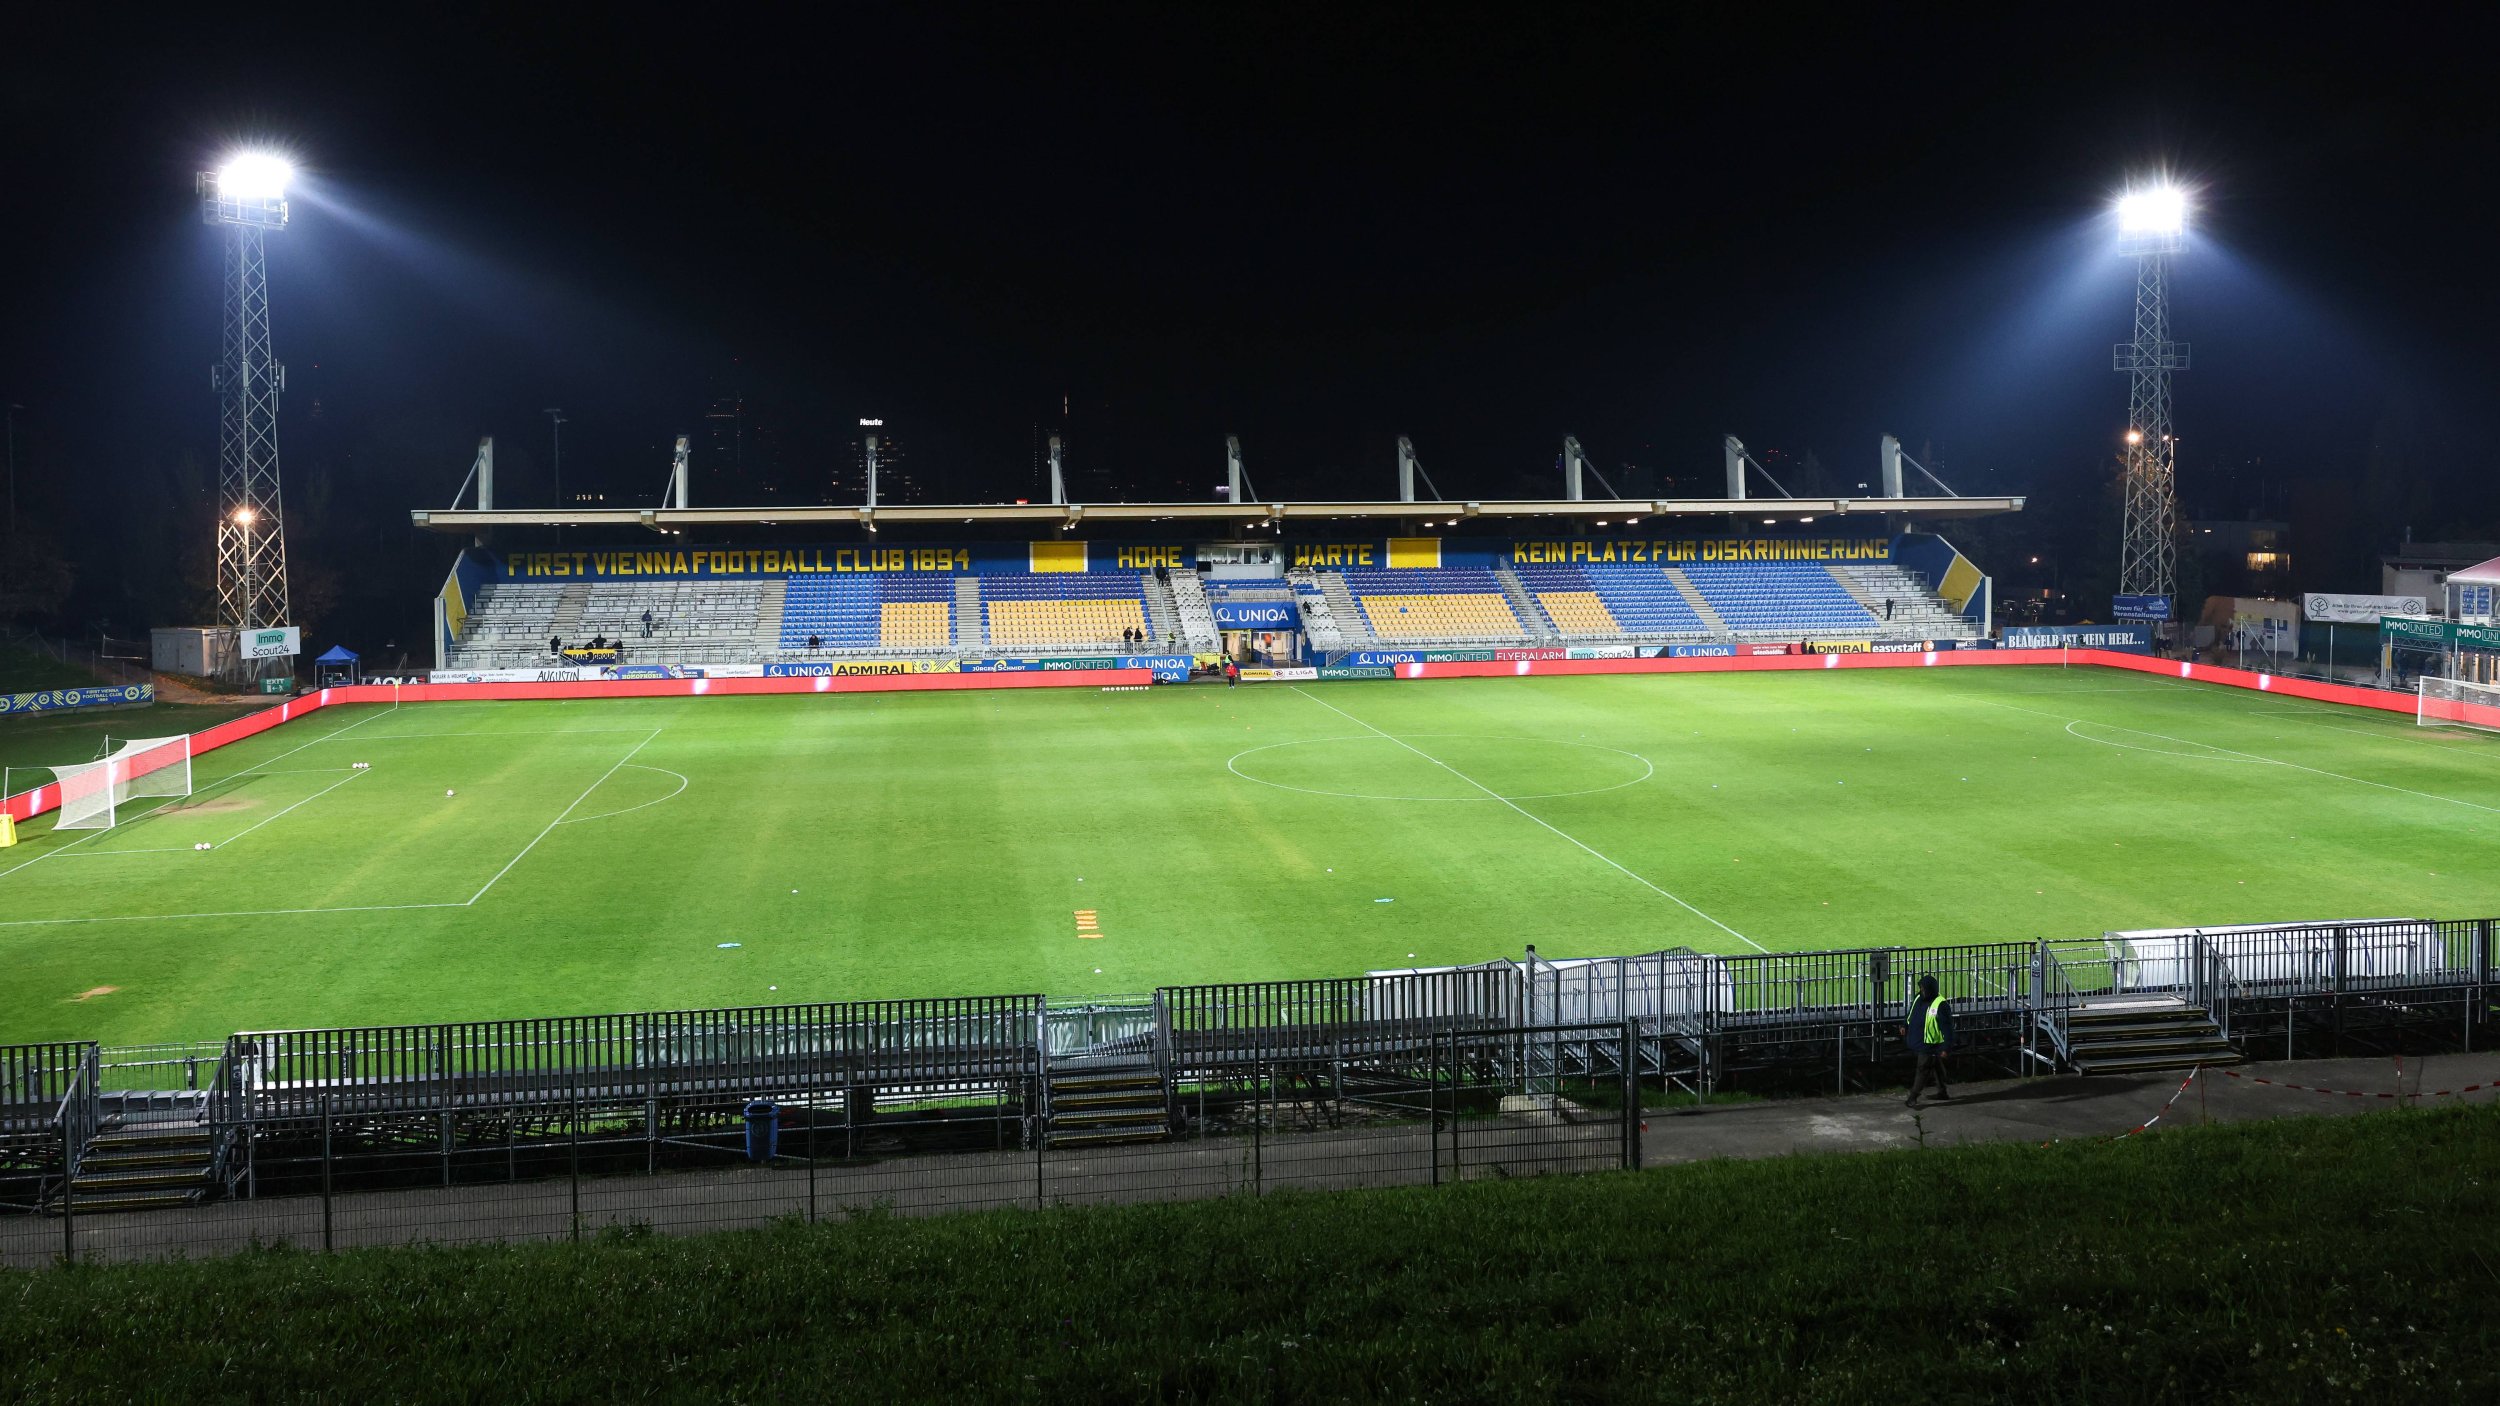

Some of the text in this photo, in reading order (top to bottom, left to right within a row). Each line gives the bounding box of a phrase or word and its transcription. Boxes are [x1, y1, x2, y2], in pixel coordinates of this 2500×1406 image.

[859, 418, 883, 426] Heute
[1118, 544, 1374, 569] HOHE WARTE
[1514, 538, 1889, 564] KEIN PLATZ FÜR DISKRIMINIERUNG
[508, 548, 970, 576] FIRST VIENNA FOOTBALL CLUB 1894
[1238, 608, 1289, 622] UNIQA
[2113, 610, 2168, 619] Veranstaltungen!
[2385, 620, 2441, 635] IMMO UNITED
[258, 634, 283, 644] Immo
[2456, 627, 2500, 641] IMMO UNI
[2008, 634, 2060, 649] BLAUGELB
[2062, 634, 2078, 647] IST
[252, 644, 290, 657] Scout24
[1640, 649, 1658, 658] SAP
[1692, 647, 1730, 657] UNIQA
[1816, 643, 1865, 654] DMIRAL
[593, 652, 616, 660] GROUP
[1376, 653, 1416, 664] UNIQA
[1427, 652, 1490, 662] IMMO UNITED
[1496, 651, 1564, 661] FLYERALARM
[1571, 651, 1595, 659] Immo
[1044, 660, 1111, 671] IMMO UNITED
[1145, 658, 1186, 669] UNIQA
[537, 668, 580, 682] AUGUSTIN
[788, 665, 833, 677] UNIQA
[835, 664, 908, 676] ADMIRAL
[1321, 668, 1388, 677] IMMO UNITED
[1152, 671, 1180, 681] NIQA
